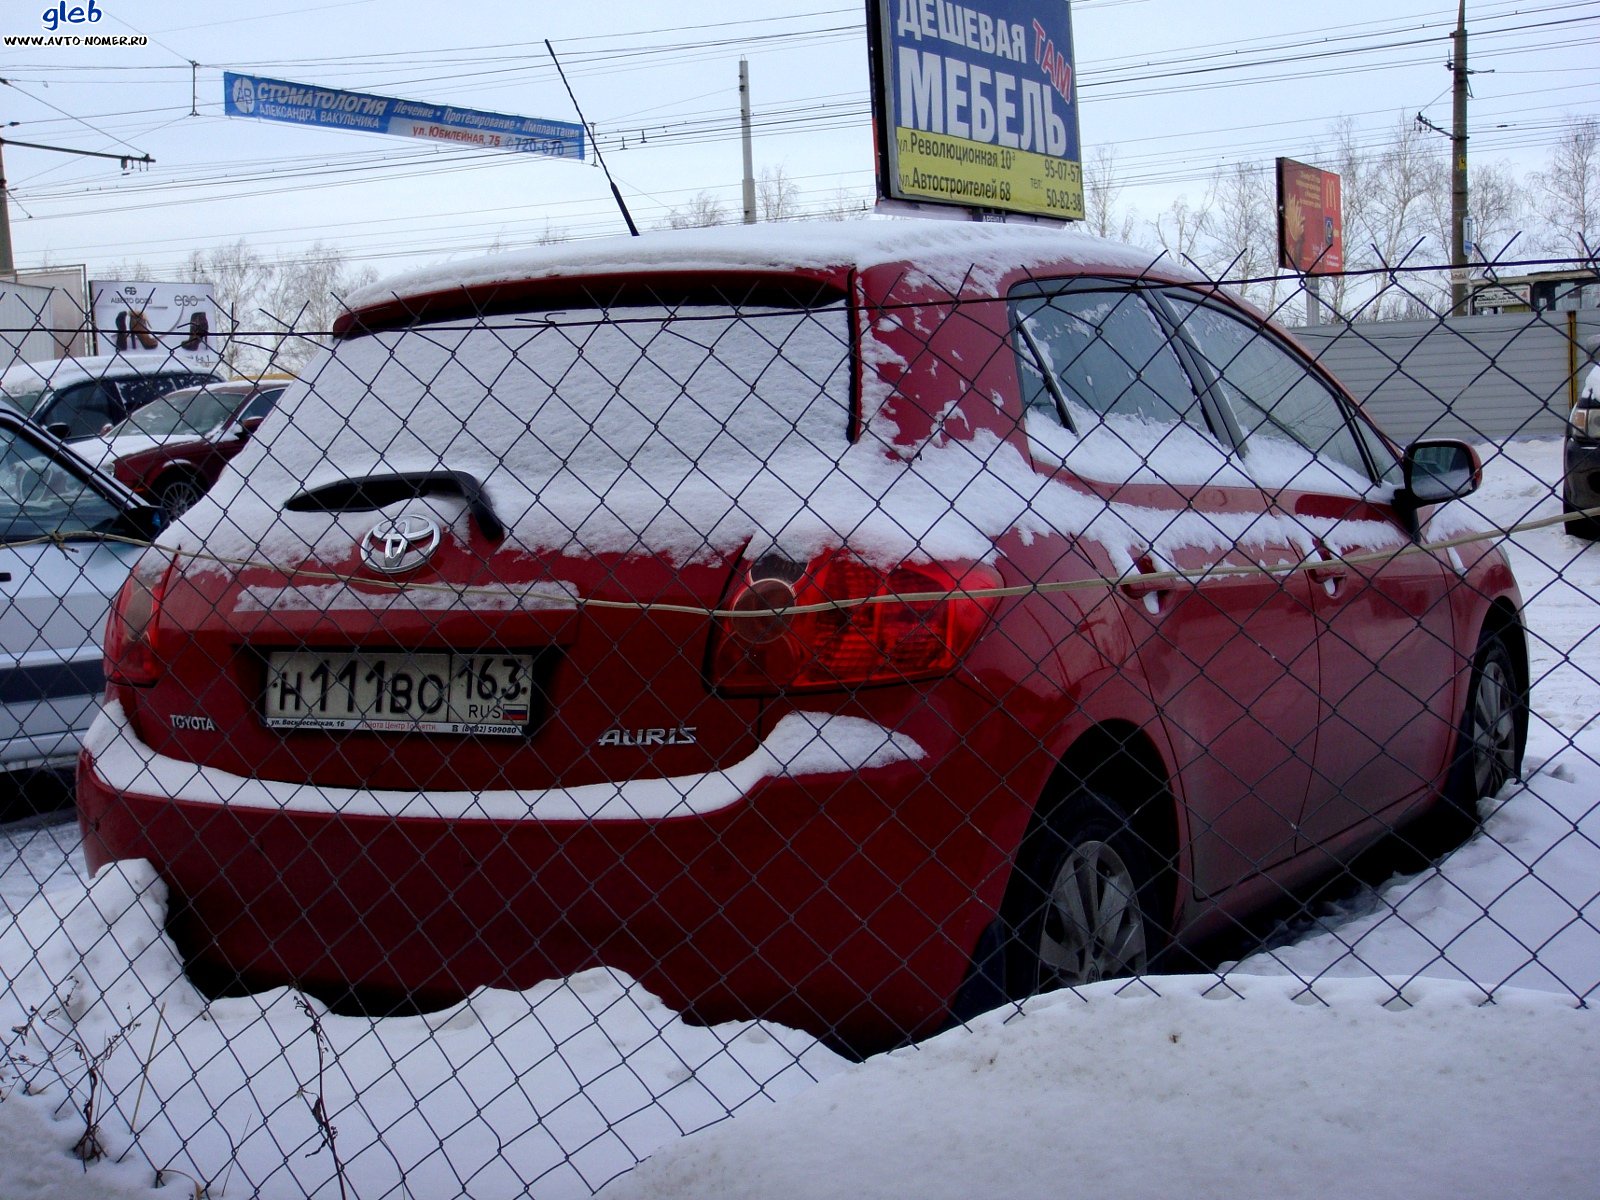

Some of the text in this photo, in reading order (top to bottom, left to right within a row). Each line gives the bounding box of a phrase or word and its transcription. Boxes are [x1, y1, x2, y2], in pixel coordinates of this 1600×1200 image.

[897, 0, 1027, 64] ДЕШЕВАЯ
[1032, 18, 1072, 104] ТАМ
[257, 82, 388, 117] СТОМАТОЛОГИЯ
[898, 46, 1067, 157] МЕБЕЛЬ
[259, 104, 317, 122] АЛЕКСАНДРА
[393, 101, 434, 119] Лечение
[444, 107, 515, 130] Протезирование
[488, 134, 501, 148] 75
[1044, 158, 1080, 183] 95-07-57
[1000, 181, 1011, 201] 68
[1046, 188, 1082, 212] 50-82-38
[457, 657, 523, 700] 163
[170, 714, 216, 732] TOYOTA
[468, 703, 501, 719] RUS
[336, 720, 346, 728] 16
[407, 722, 437, 731] Тоьятти
[597, 727, 697, 746] AURIS
